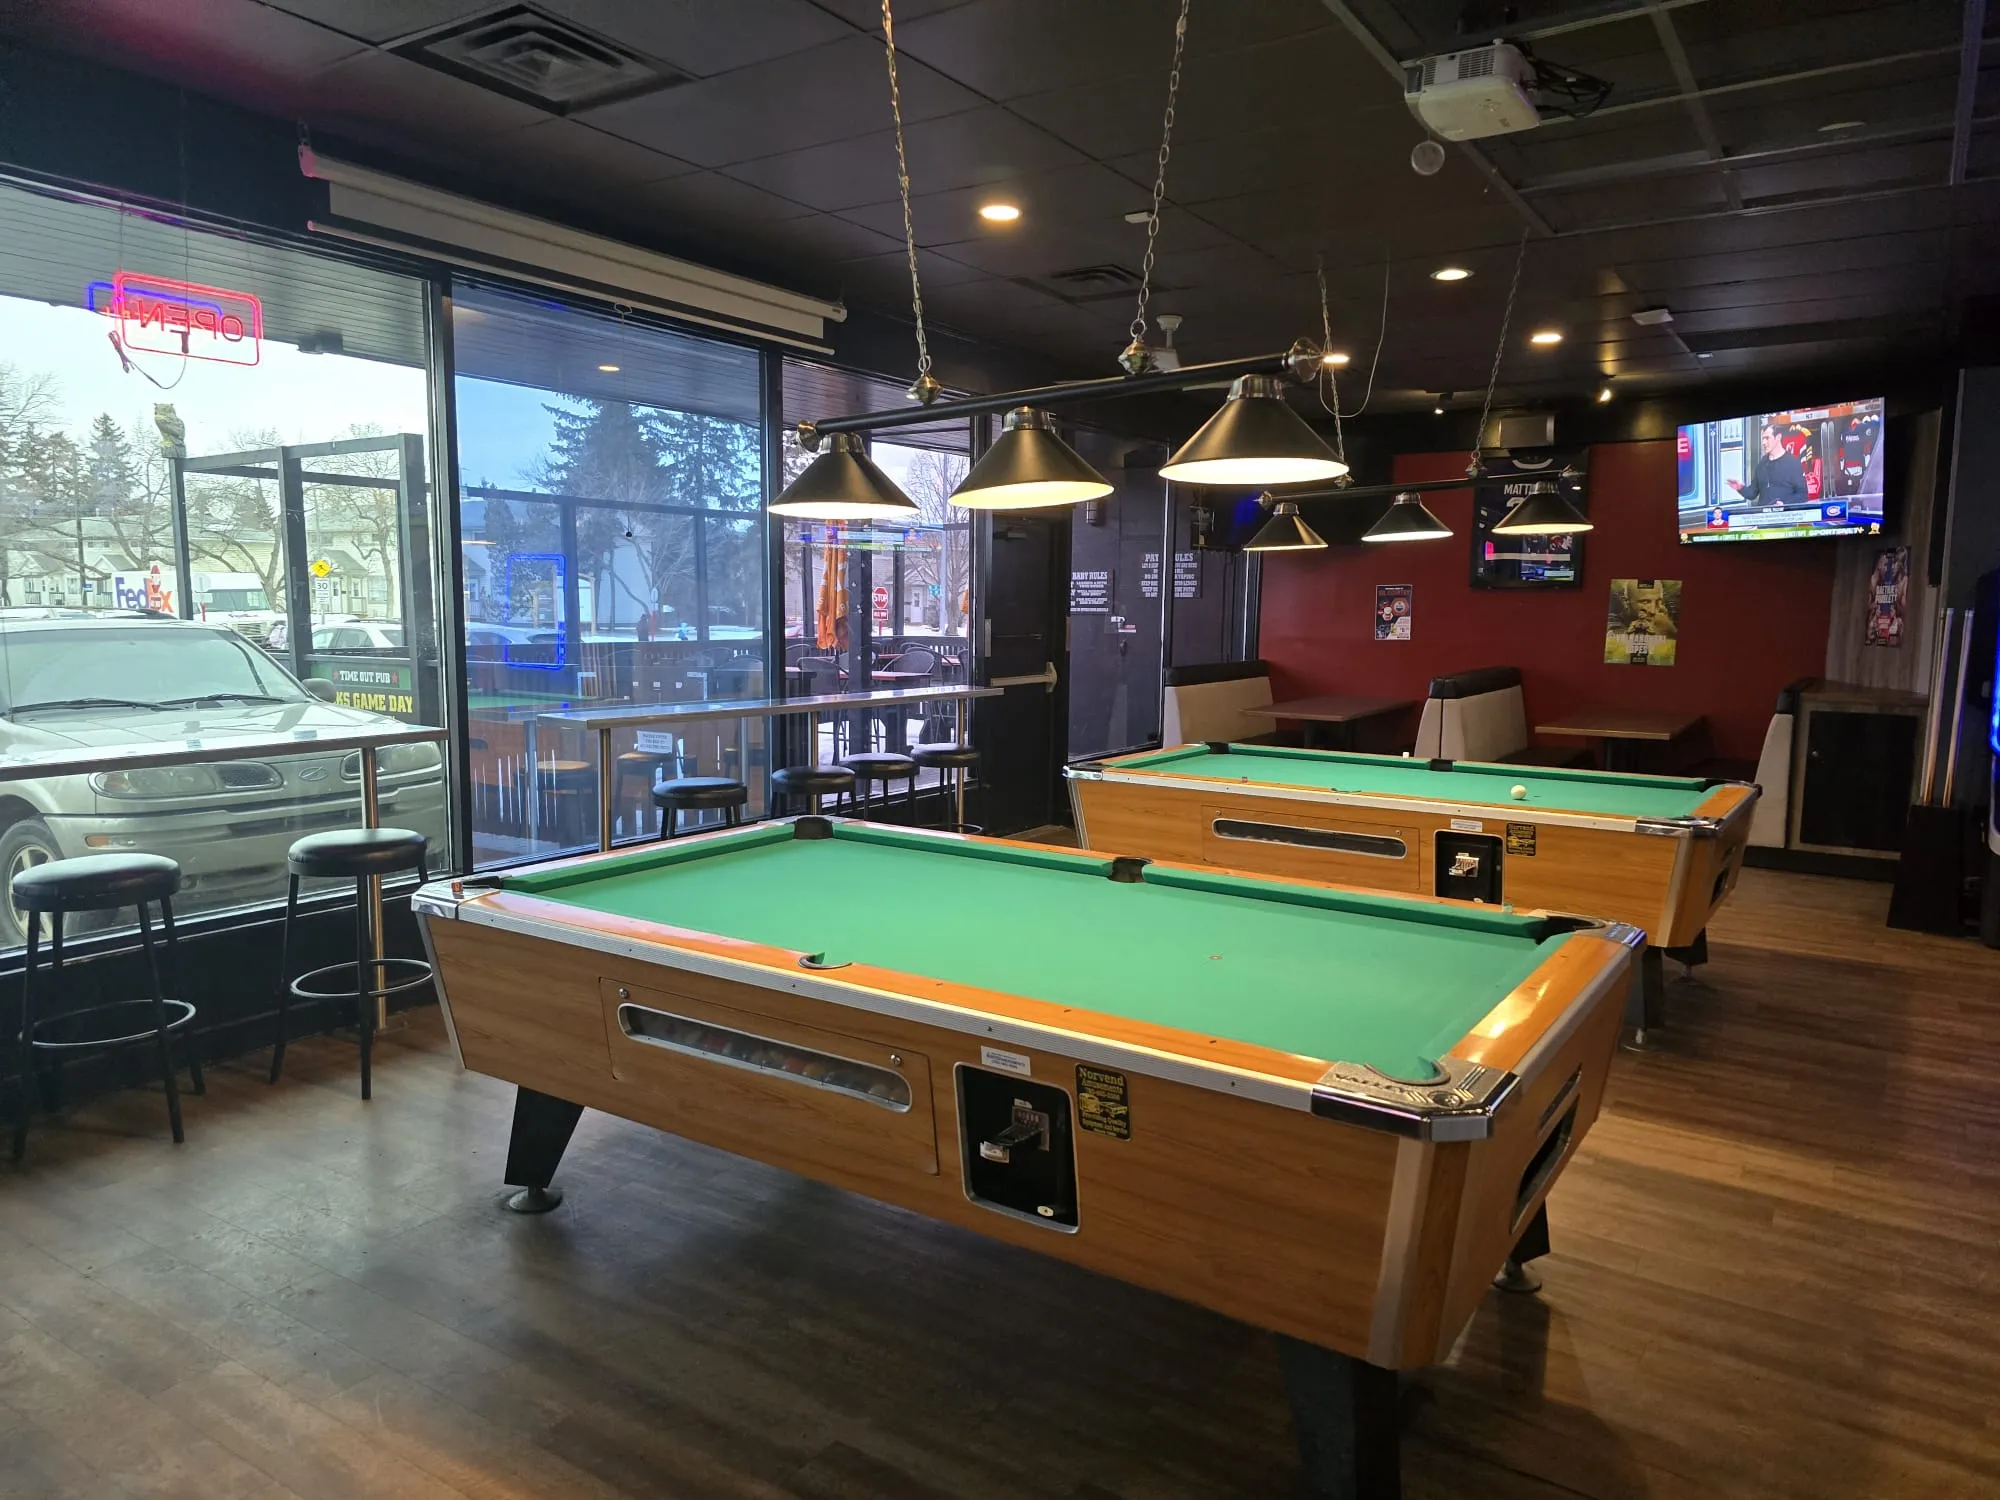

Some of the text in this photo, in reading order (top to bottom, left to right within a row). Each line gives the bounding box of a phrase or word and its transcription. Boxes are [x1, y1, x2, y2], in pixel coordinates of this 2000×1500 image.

[1175, 553, 1194, 562] ULES
[317, 582, 328, 590] 30
[873, 593, 888, 601] STOP
[340, 670, 391, 683] TIME OUT PUB
[353, 693, 386, 712] GAME
[389, 695, 413, 713] DAY
[1079, 1067, 1124, 1086] Norvend
